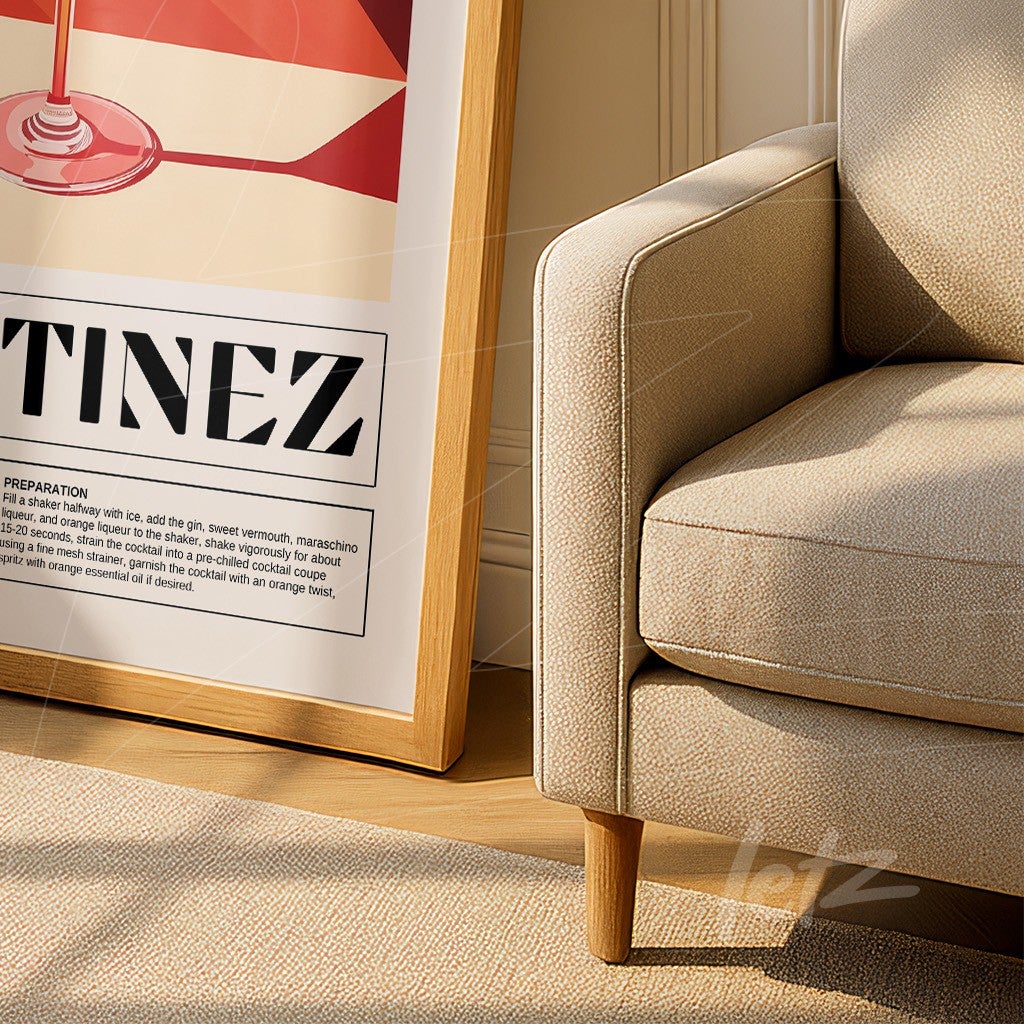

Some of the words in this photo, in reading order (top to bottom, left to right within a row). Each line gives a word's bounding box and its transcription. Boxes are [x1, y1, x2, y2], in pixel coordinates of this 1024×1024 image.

[4, 477, 87, 499] PREPARATION
[2, 492, 16, 503] Fill
[18, 496, 25, 505] a
[27, 496, 61, 510] shaker
[63, 500, 101, 518] halfway
[102, 507, 123, 519] with
[146, 514, 165, 525] add
[168, 516, 184, 528] the
[208, 523, 239, 536] sweet
[296, 536, 358, 553] maraschino
[39, 514, 57, 525] and
[59, 517, 94, 532] orange
[97, 520, 131, 535] liqueur
[133, 526, 143, 537] to
[145, 528, 161, 540] the
[204, 537, 235, 551] shake
[238, 542, 291, 561] vigorously
[294, 549, 308, 561] for
[310, 552, 341, 566] about
[0, 522, 27, 535] 15-20
[76, 534, 103, 547] strain
[106, 538, 122, 550] the
[124, 542, 162, 556] cocktail
[165, 546, 183, 559] into
[186, 551, 193, 560] a
[195, 553, 249, 569] pre-chilled
[251, 561, 291, 575] cocktail
[293, 567, 326, 581] coupe
[0, 538, 24, 553] using
[27, 543, 33, 551] a
[36, 542, 54, 554] fine
[56, 547, 83, 559] mesh
[128, 558, 165, 571] garnish
[169, 562, 184, 574] the
[187, 567, 226, 581] cocktail
[228, 572, 249, 584] with
[252, 577, 265, 586] an
[268, 579, 305, 595] orange
[26, 556, 45, 568] with
[48, 561, 82, 576] orange
[84, 567, 129, 581] essential
[131, 572, 143, 583] oil
[146, 574, 152, 585] if
[154, 576, 194, 591] desired.
